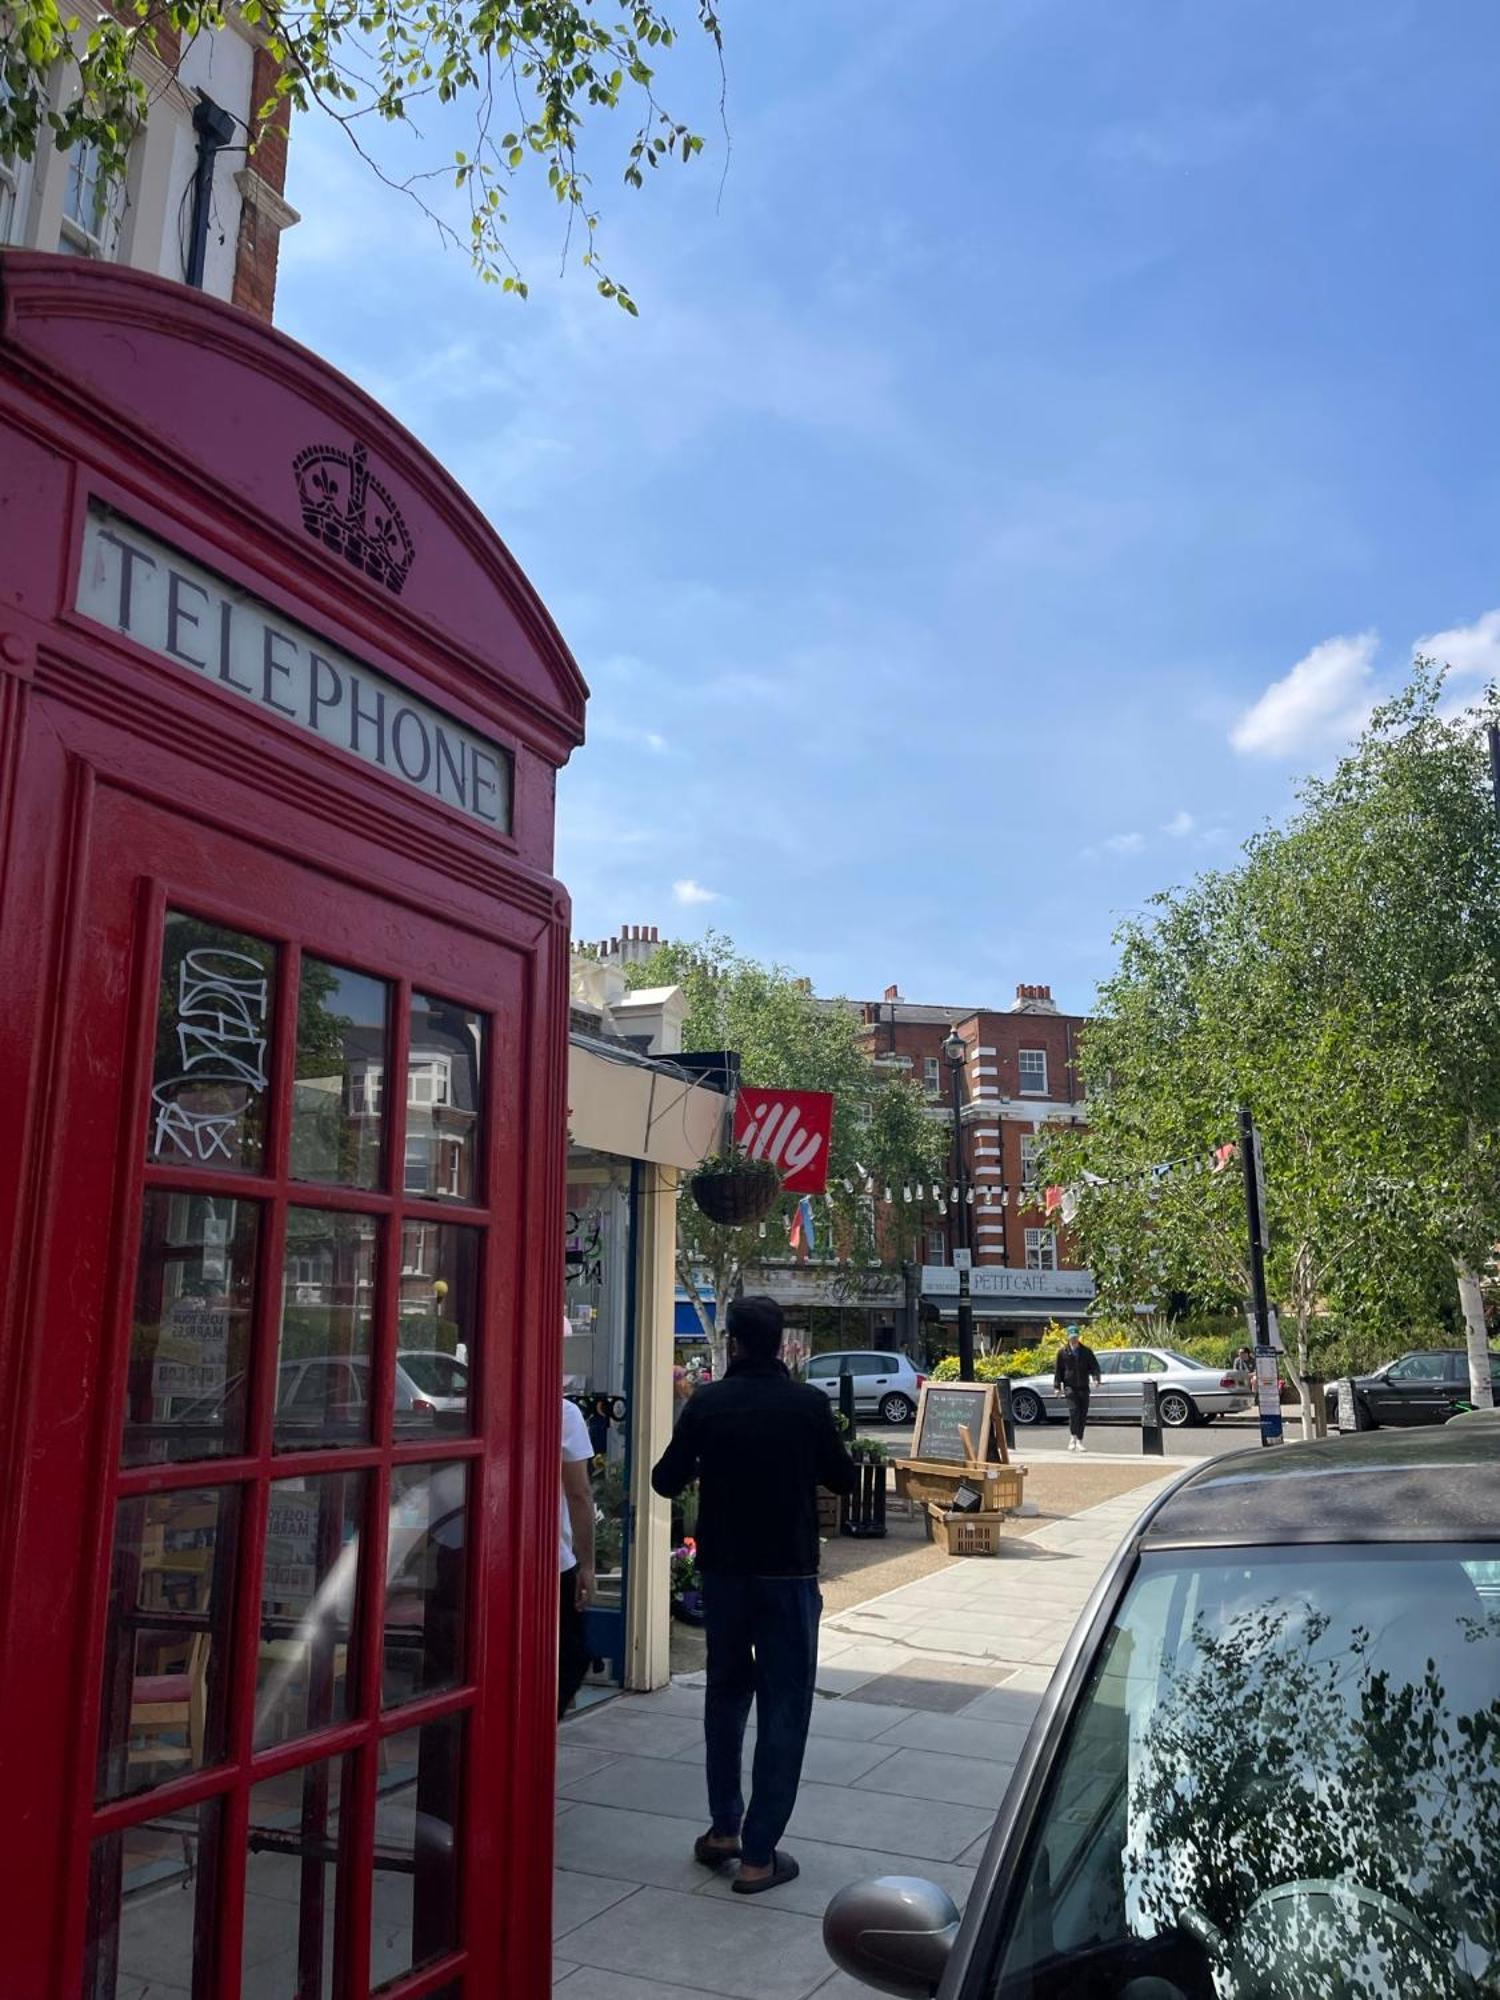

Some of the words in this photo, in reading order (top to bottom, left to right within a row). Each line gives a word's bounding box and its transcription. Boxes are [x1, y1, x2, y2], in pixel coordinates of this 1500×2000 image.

[97, 529, 498, 822] TELEPHONE
[737, 1102, 823, 1183] illy
[974, 1273, 1012, 1291] PETIT
